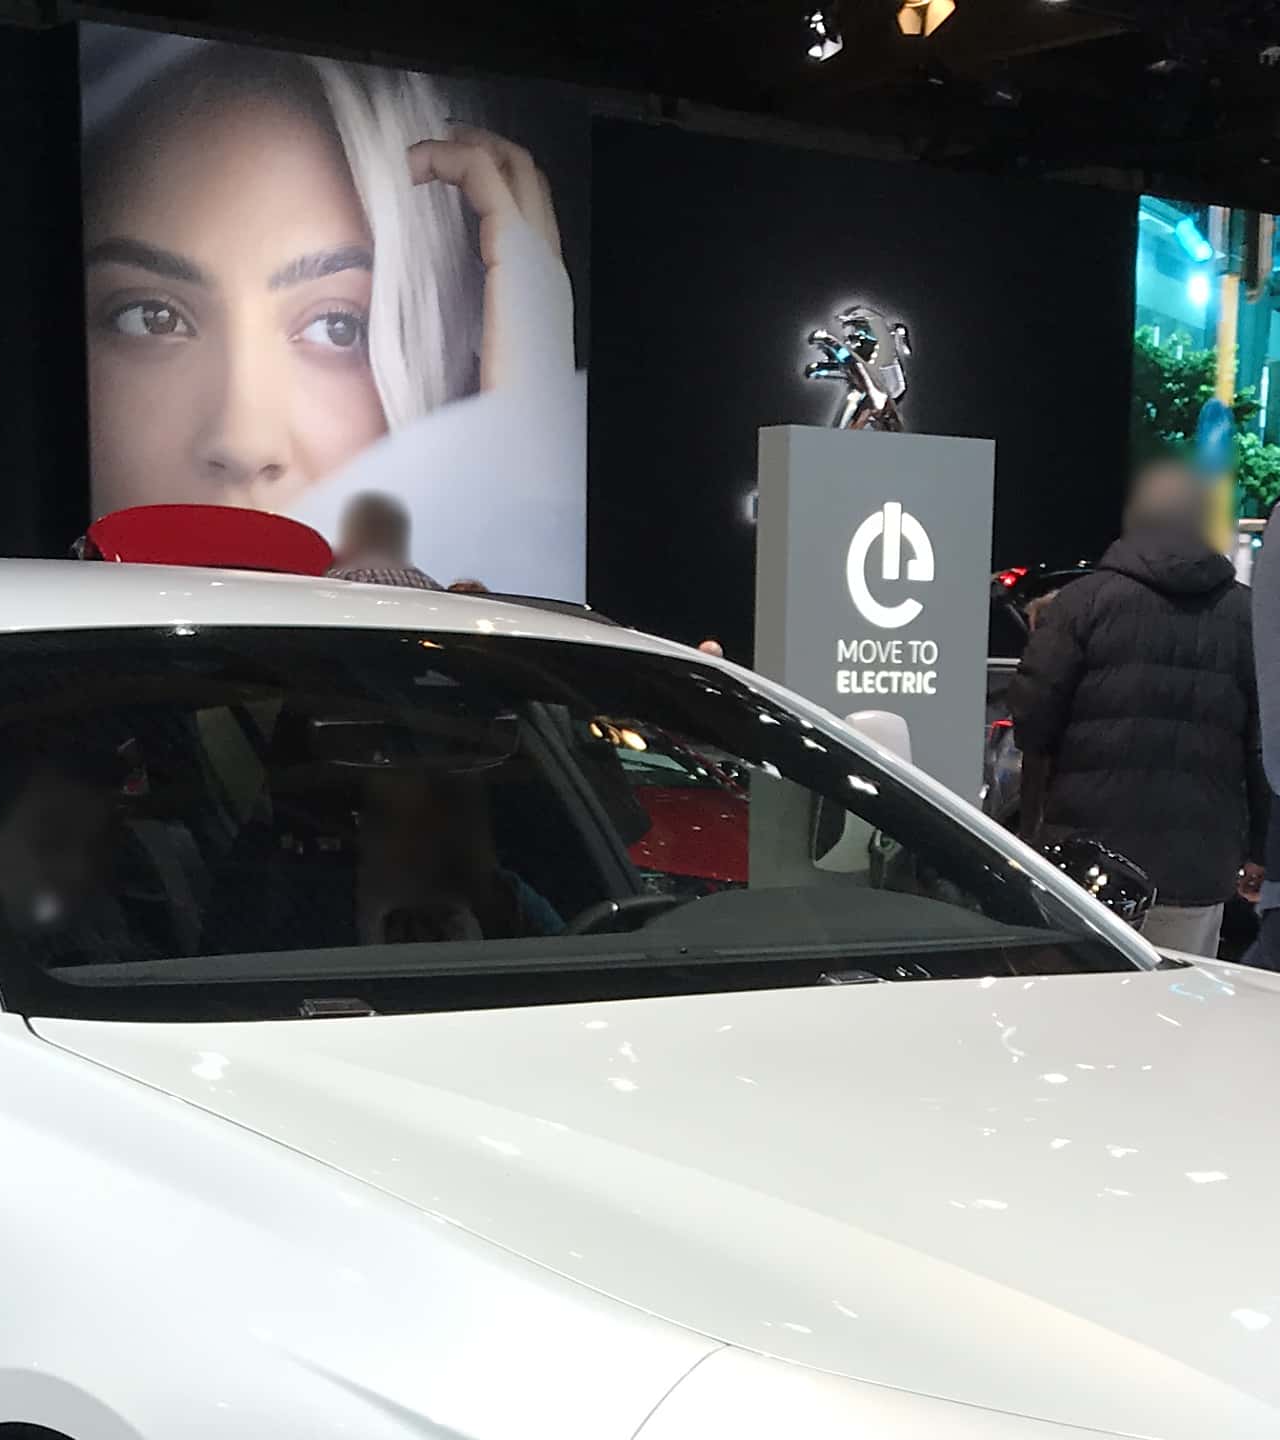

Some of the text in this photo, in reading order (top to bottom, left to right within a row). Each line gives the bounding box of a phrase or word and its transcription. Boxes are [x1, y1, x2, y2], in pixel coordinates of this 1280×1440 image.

[837, 639, 939, 665] MOVE TO
[836, 669, 937, 695] ELECTRIC
